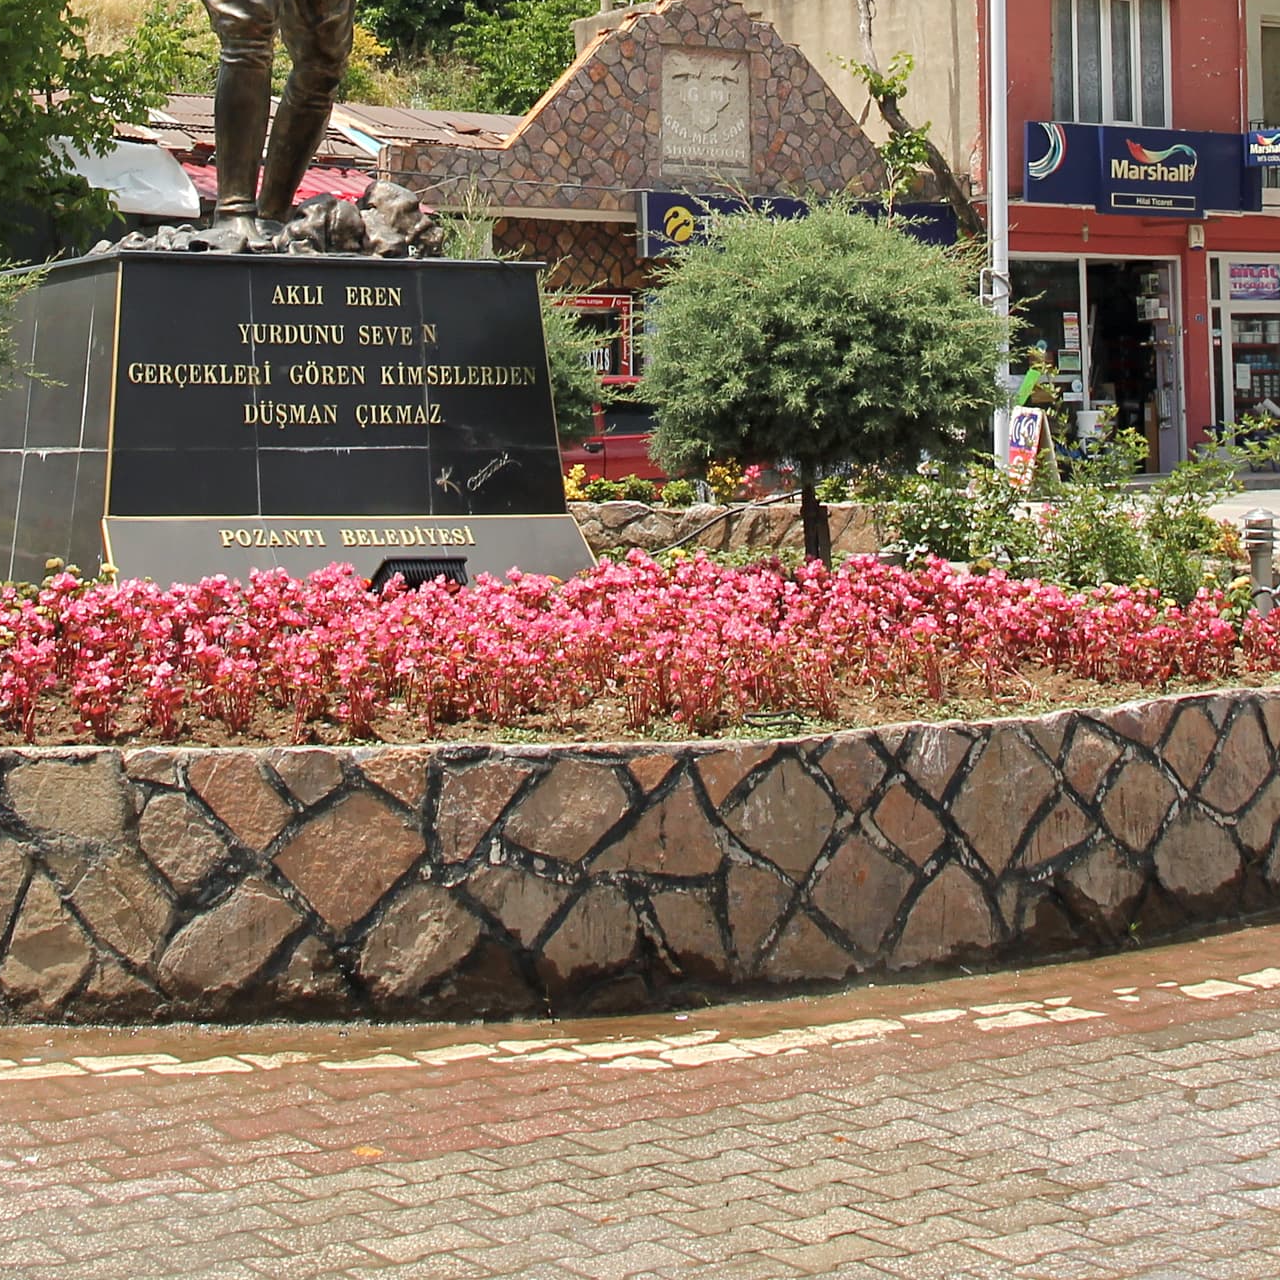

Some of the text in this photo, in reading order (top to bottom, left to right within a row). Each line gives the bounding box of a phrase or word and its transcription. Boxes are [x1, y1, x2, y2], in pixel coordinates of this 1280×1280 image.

[1111, 159, 1191, 182] Marshall
[271, 284, 402, 307] AKLI EREN
[238, 323, 438, 347] YURDUNU SEVEN
[128, 361, 536, 388] GERÇEKLERİ GÖREN KİMSELERDEN
[244, 400, 338, 429] DÜŞMAN
[218, 525, 476, 547] POZANTI BELEDİYESİ
